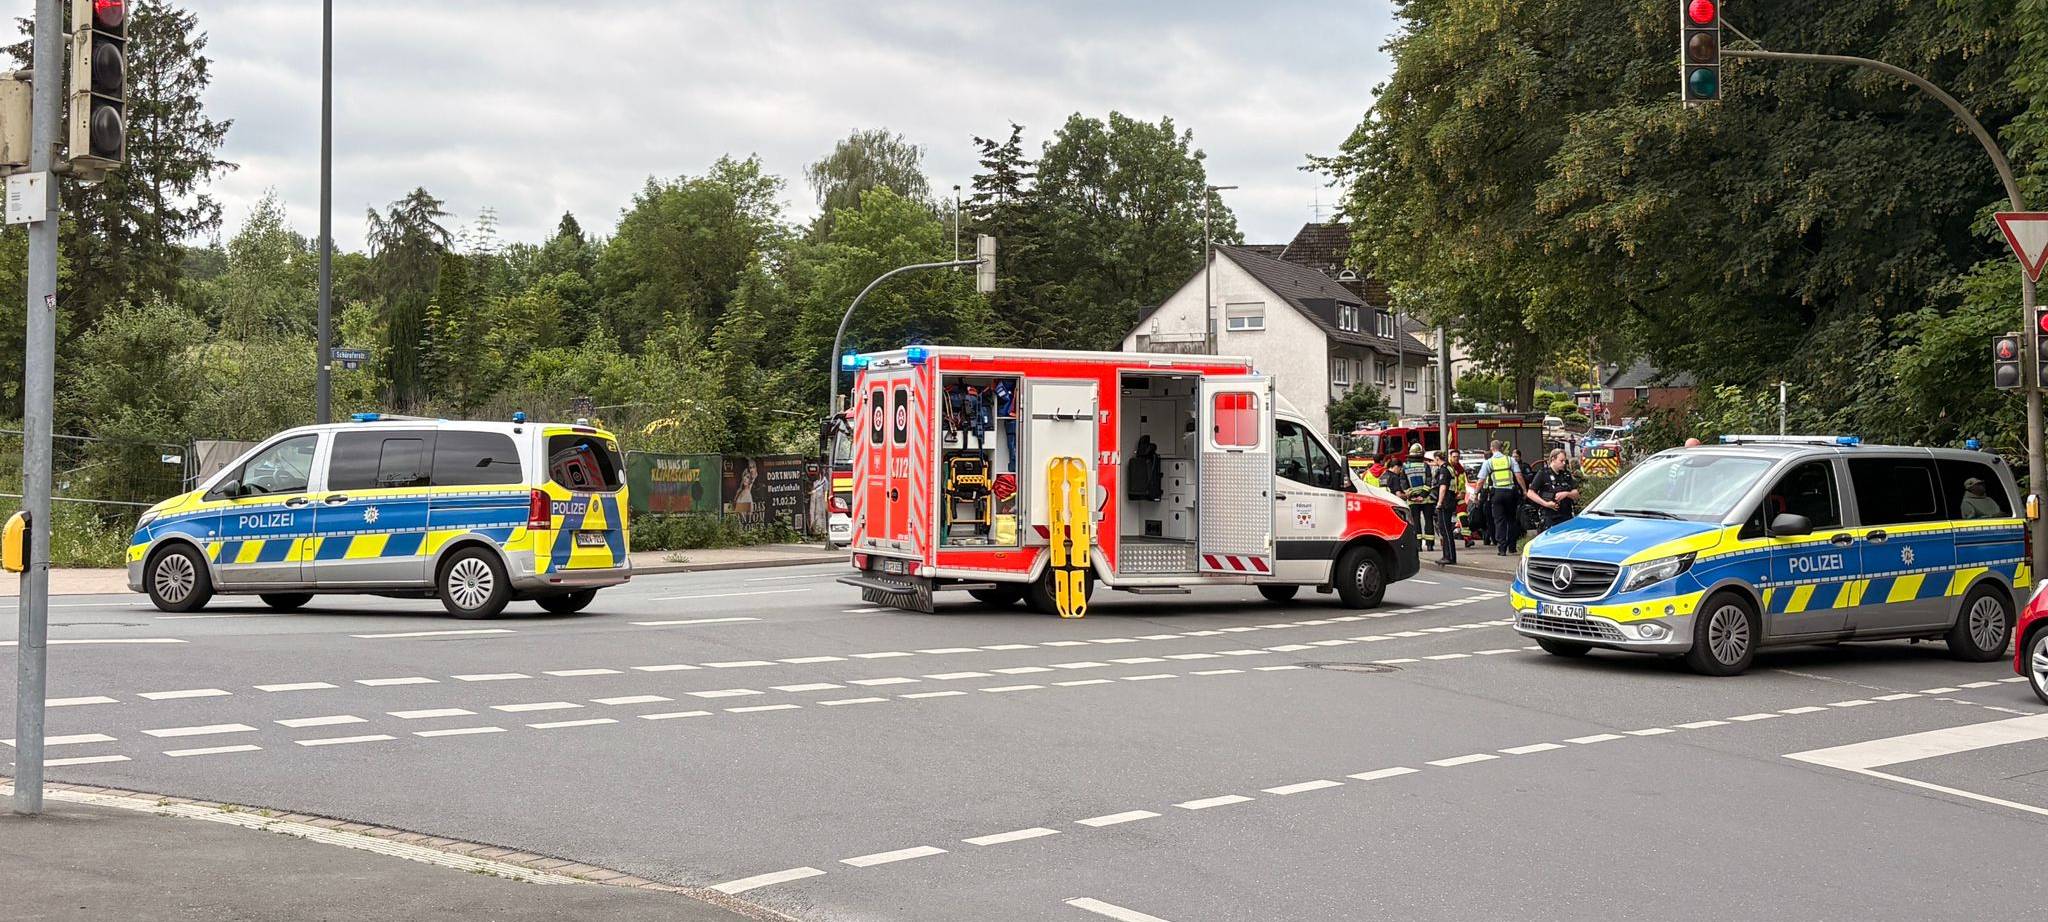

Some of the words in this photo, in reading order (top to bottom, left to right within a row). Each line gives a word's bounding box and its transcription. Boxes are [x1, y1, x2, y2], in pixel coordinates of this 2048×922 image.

[894, 457, 909, 478] 112
[651, 468, 700, 482] KLIMASCHUTZ
[766, 470, 800, 481] DORTMUND
[552, 501, 586, 515] POLIZEI
[1347, 501, 1361, 511] 53
[239, 512, 295, 529] POLIZEI
[1788, 553, 1844, 574] POLIZEI
